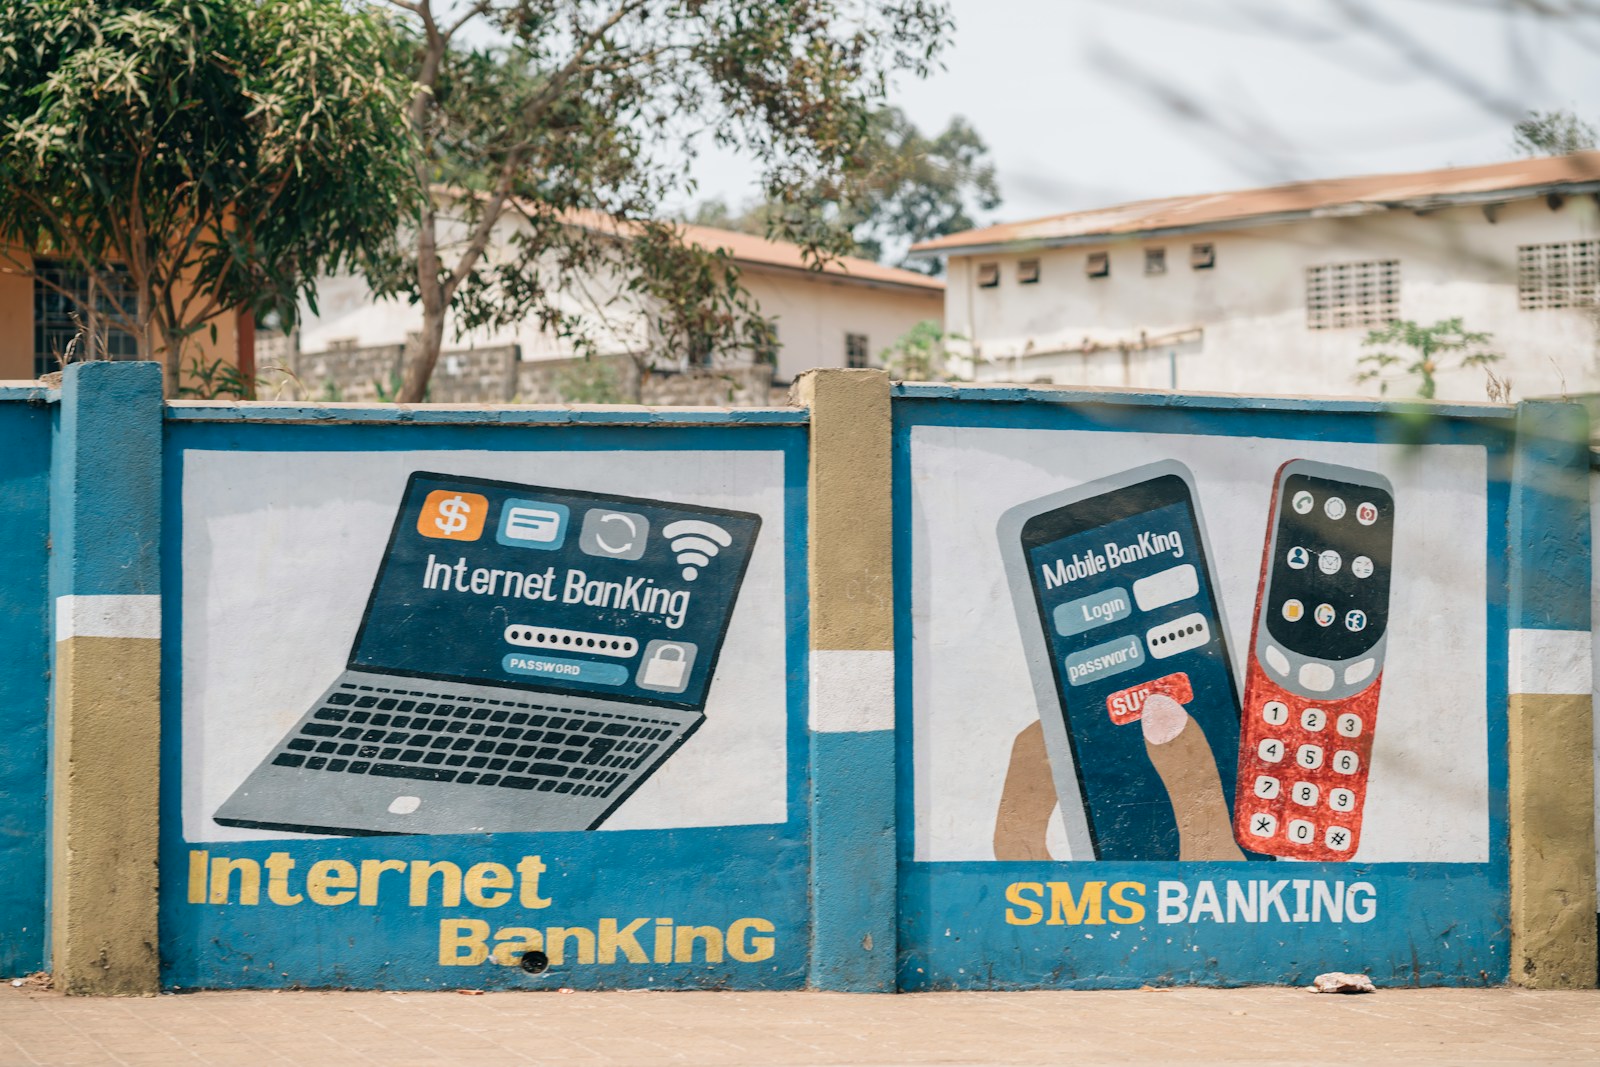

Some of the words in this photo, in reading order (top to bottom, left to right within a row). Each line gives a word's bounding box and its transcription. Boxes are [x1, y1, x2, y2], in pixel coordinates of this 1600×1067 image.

[422, 554, 557, 602] Internet
[1041, 550, 1107, 590] Mobile
[1081, 598, 1125, 622] Login
[510, 658, 581, 676] PASSWORD
[1069, 642, 1139, 682] password
[1271, 707, 1279, 721] 1
[1307, 713, 1317, 727] 2
[1345, 718, 1355, 732] 3
[1267, 744, 1276, 757] 4
[1305, 750, 1316, 765] 5
[1341, 755, 1351, 770] 6
[1262, 781, 1273, 793] 7
[1301, 787, 1311, 801] 8
[1337, 793, 1348, 807] 9
[1297, 825, 1308, 839] 0
[187, 850, 552, 910] Internet
[1005, 881, 1146, 926] SMS
[1157, 879, 1377, 925] BANKING
